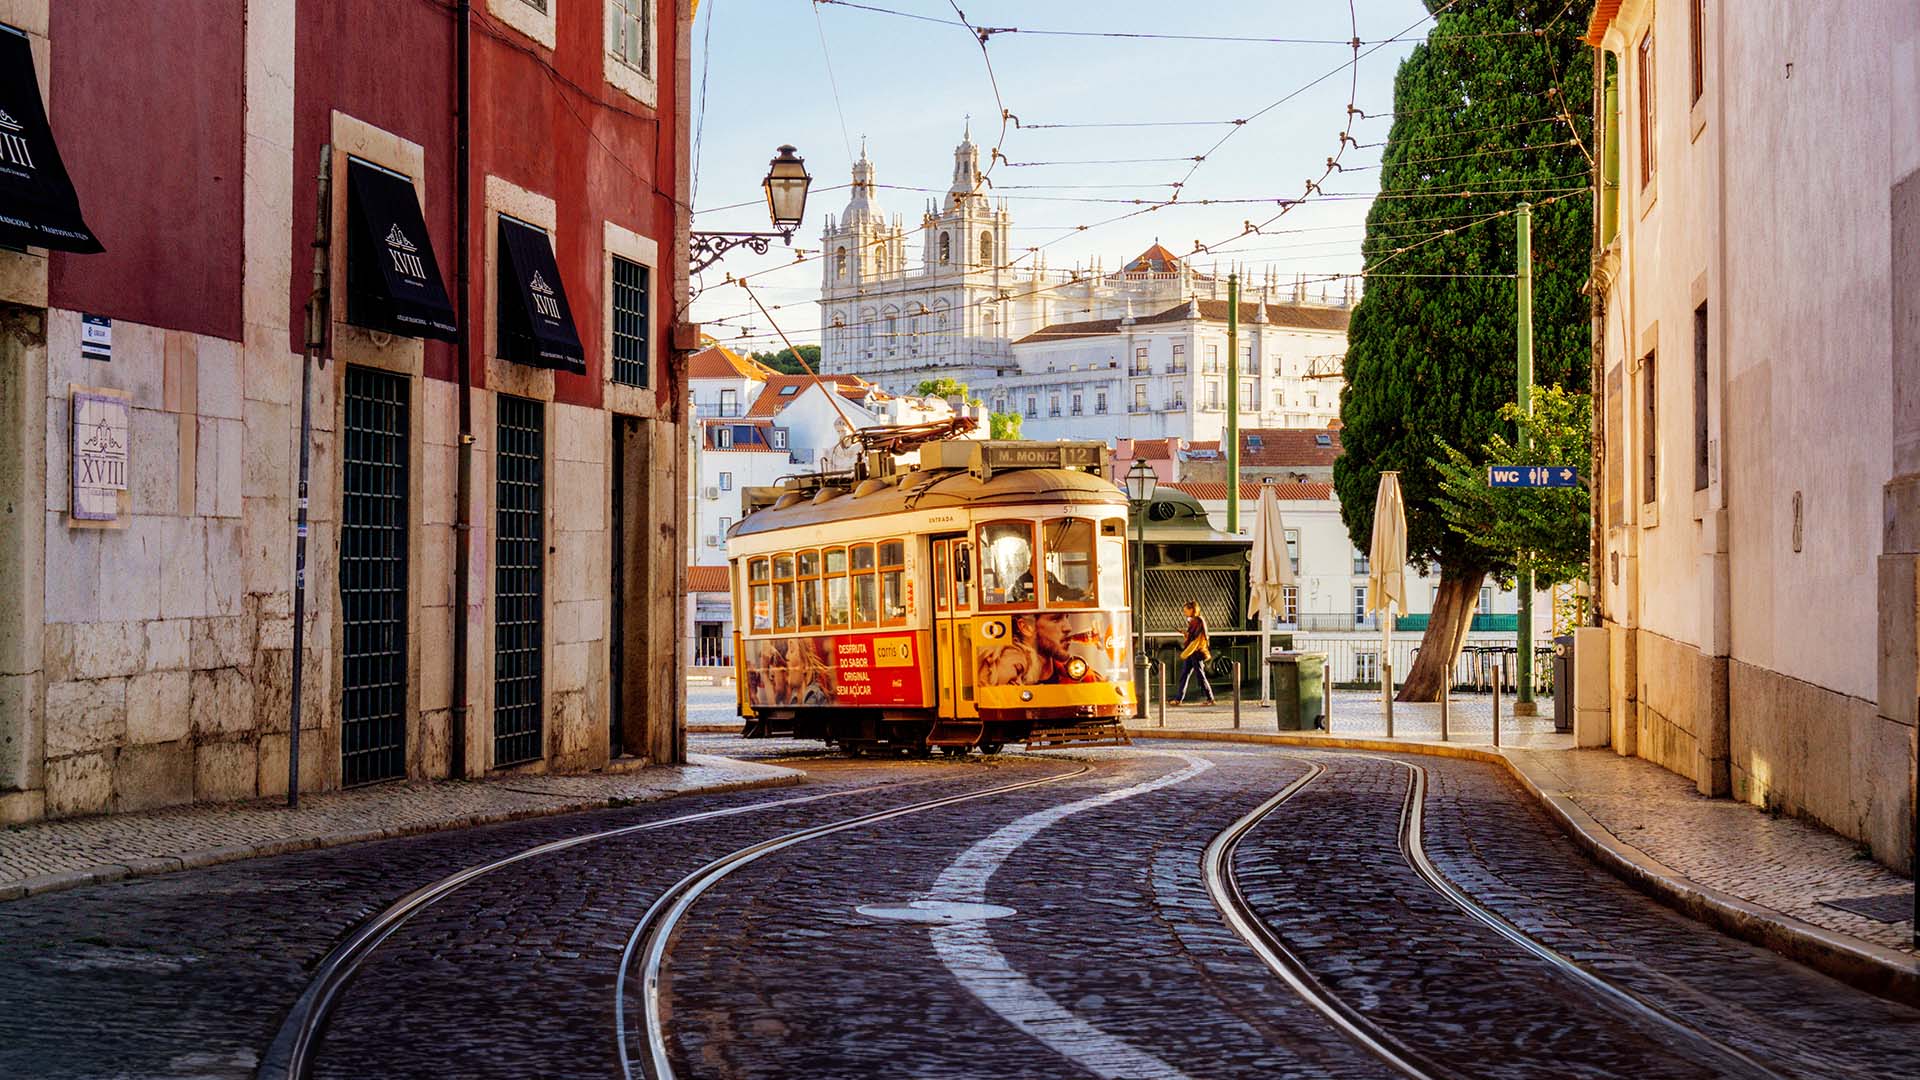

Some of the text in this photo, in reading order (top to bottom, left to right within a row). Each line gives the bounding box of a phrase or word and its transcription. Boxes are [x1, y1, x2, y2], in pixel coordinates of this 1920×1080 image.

[388, 248, 426, 279] XVIII
[532, 292, 561, 319] XVIII
[999, 451, 1058, 461] M. MONIZ
[1069, 448, 1088, 461] 12
[81, 459, 124, 485] XVIII
[1494, 471, 1519, 482] WC
[838, 644, 867, 654] DESFRUTA
[840, 658, 869, 668] DO SABOR
[843, 672, 871, 682] ORIGINAL
[836, 686, 849, 696] SEM
